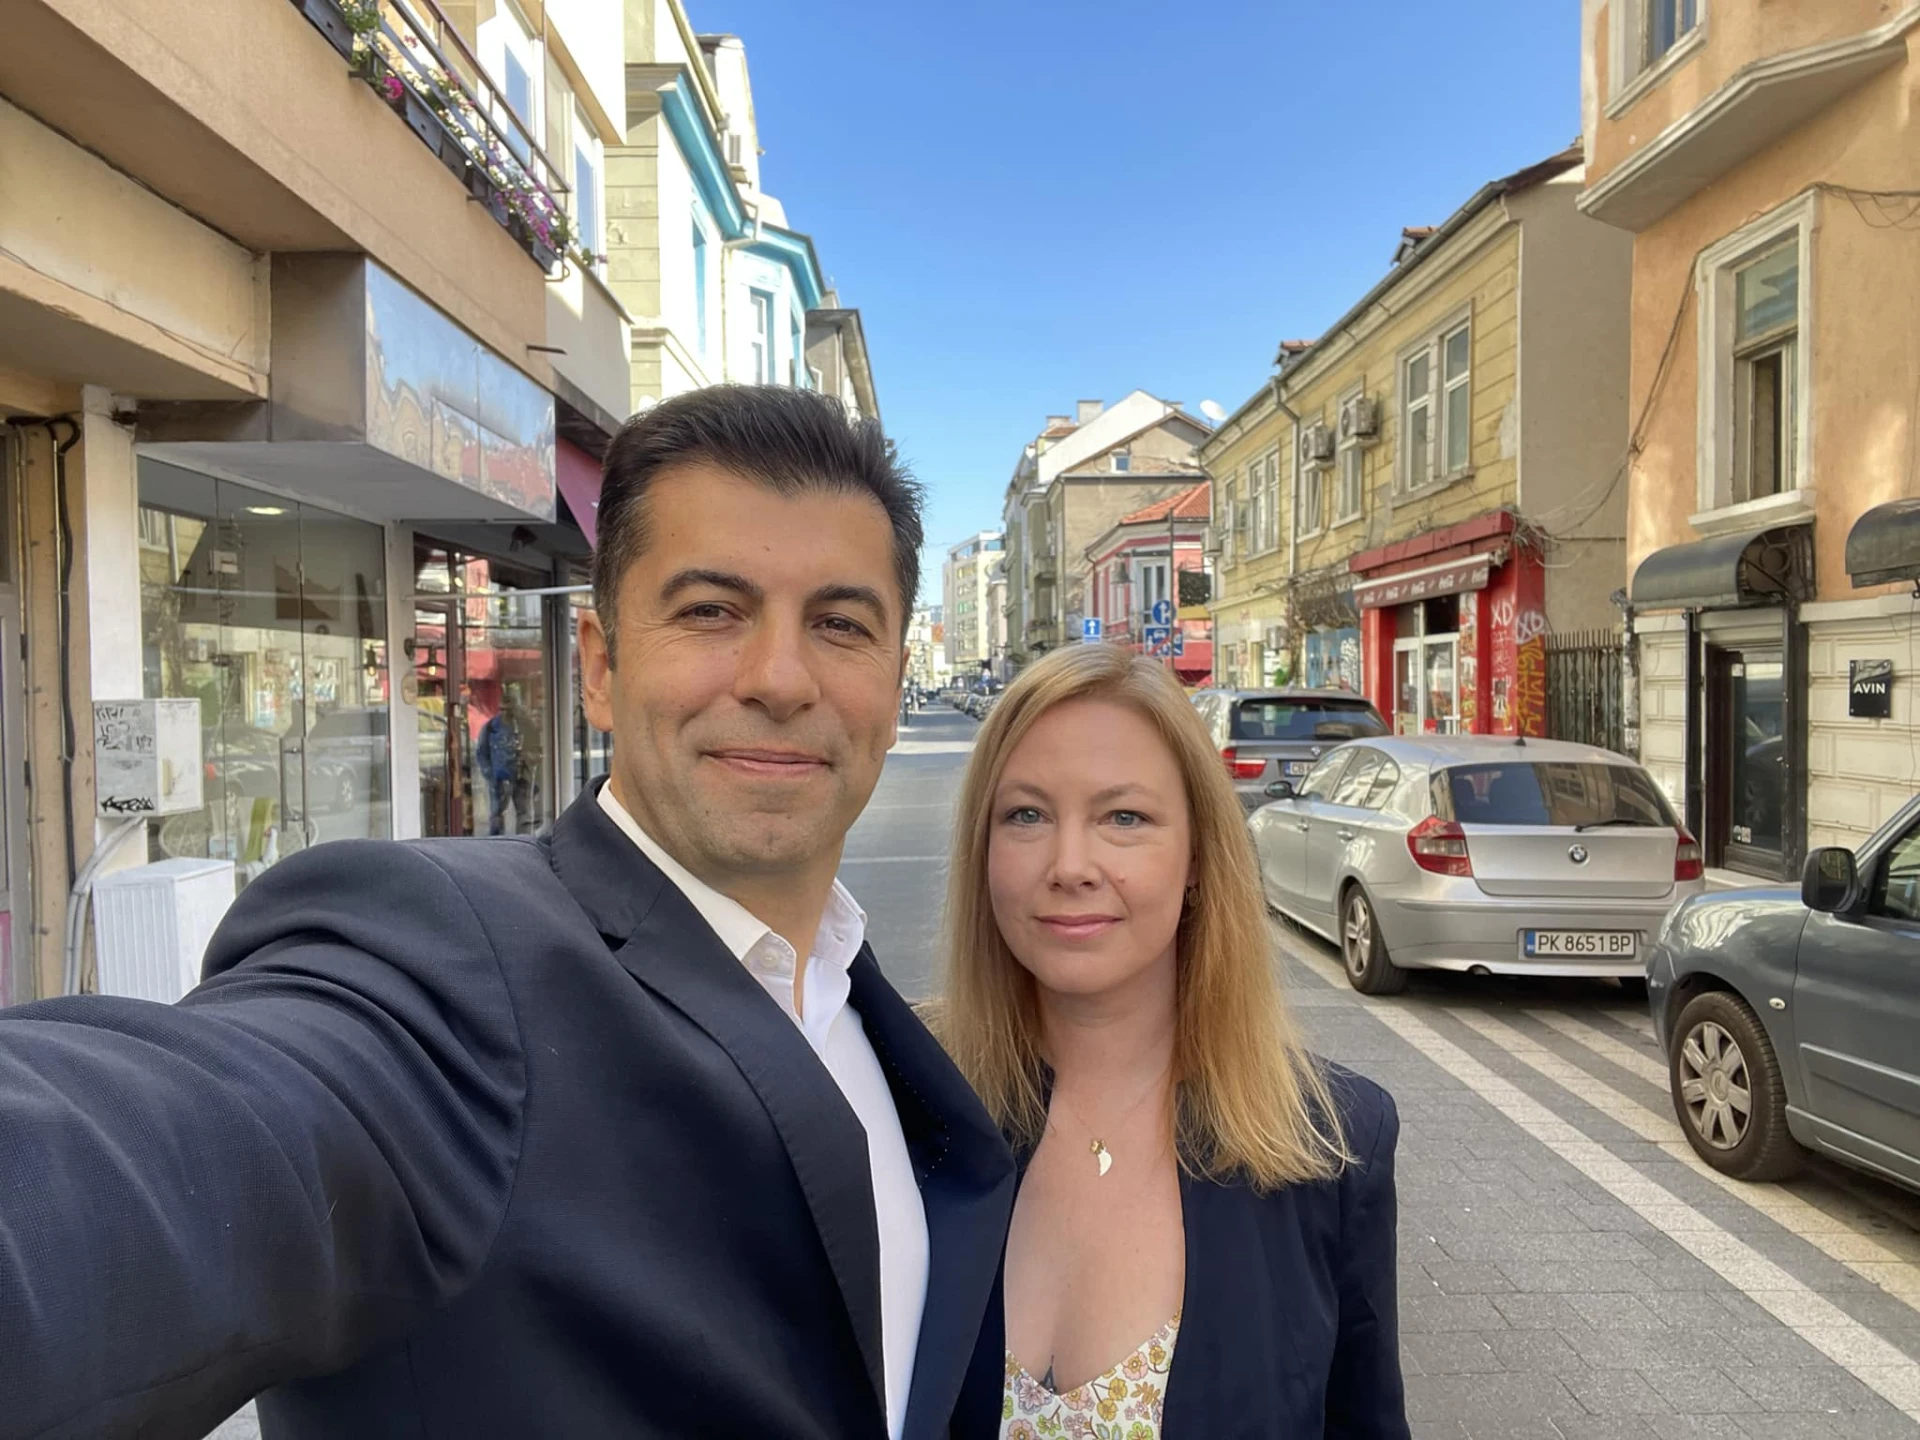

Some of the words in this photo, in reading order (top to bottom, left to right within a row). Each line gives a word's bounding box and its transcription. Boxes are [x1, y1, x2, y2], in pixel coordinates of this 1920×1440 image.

[1853, 683, 1886, 694] AVIN
[1538, 934, 1560, 951] PK
[1564, 935, 1604, 952] 8651
[1609, 935, 1631, 952] BP
